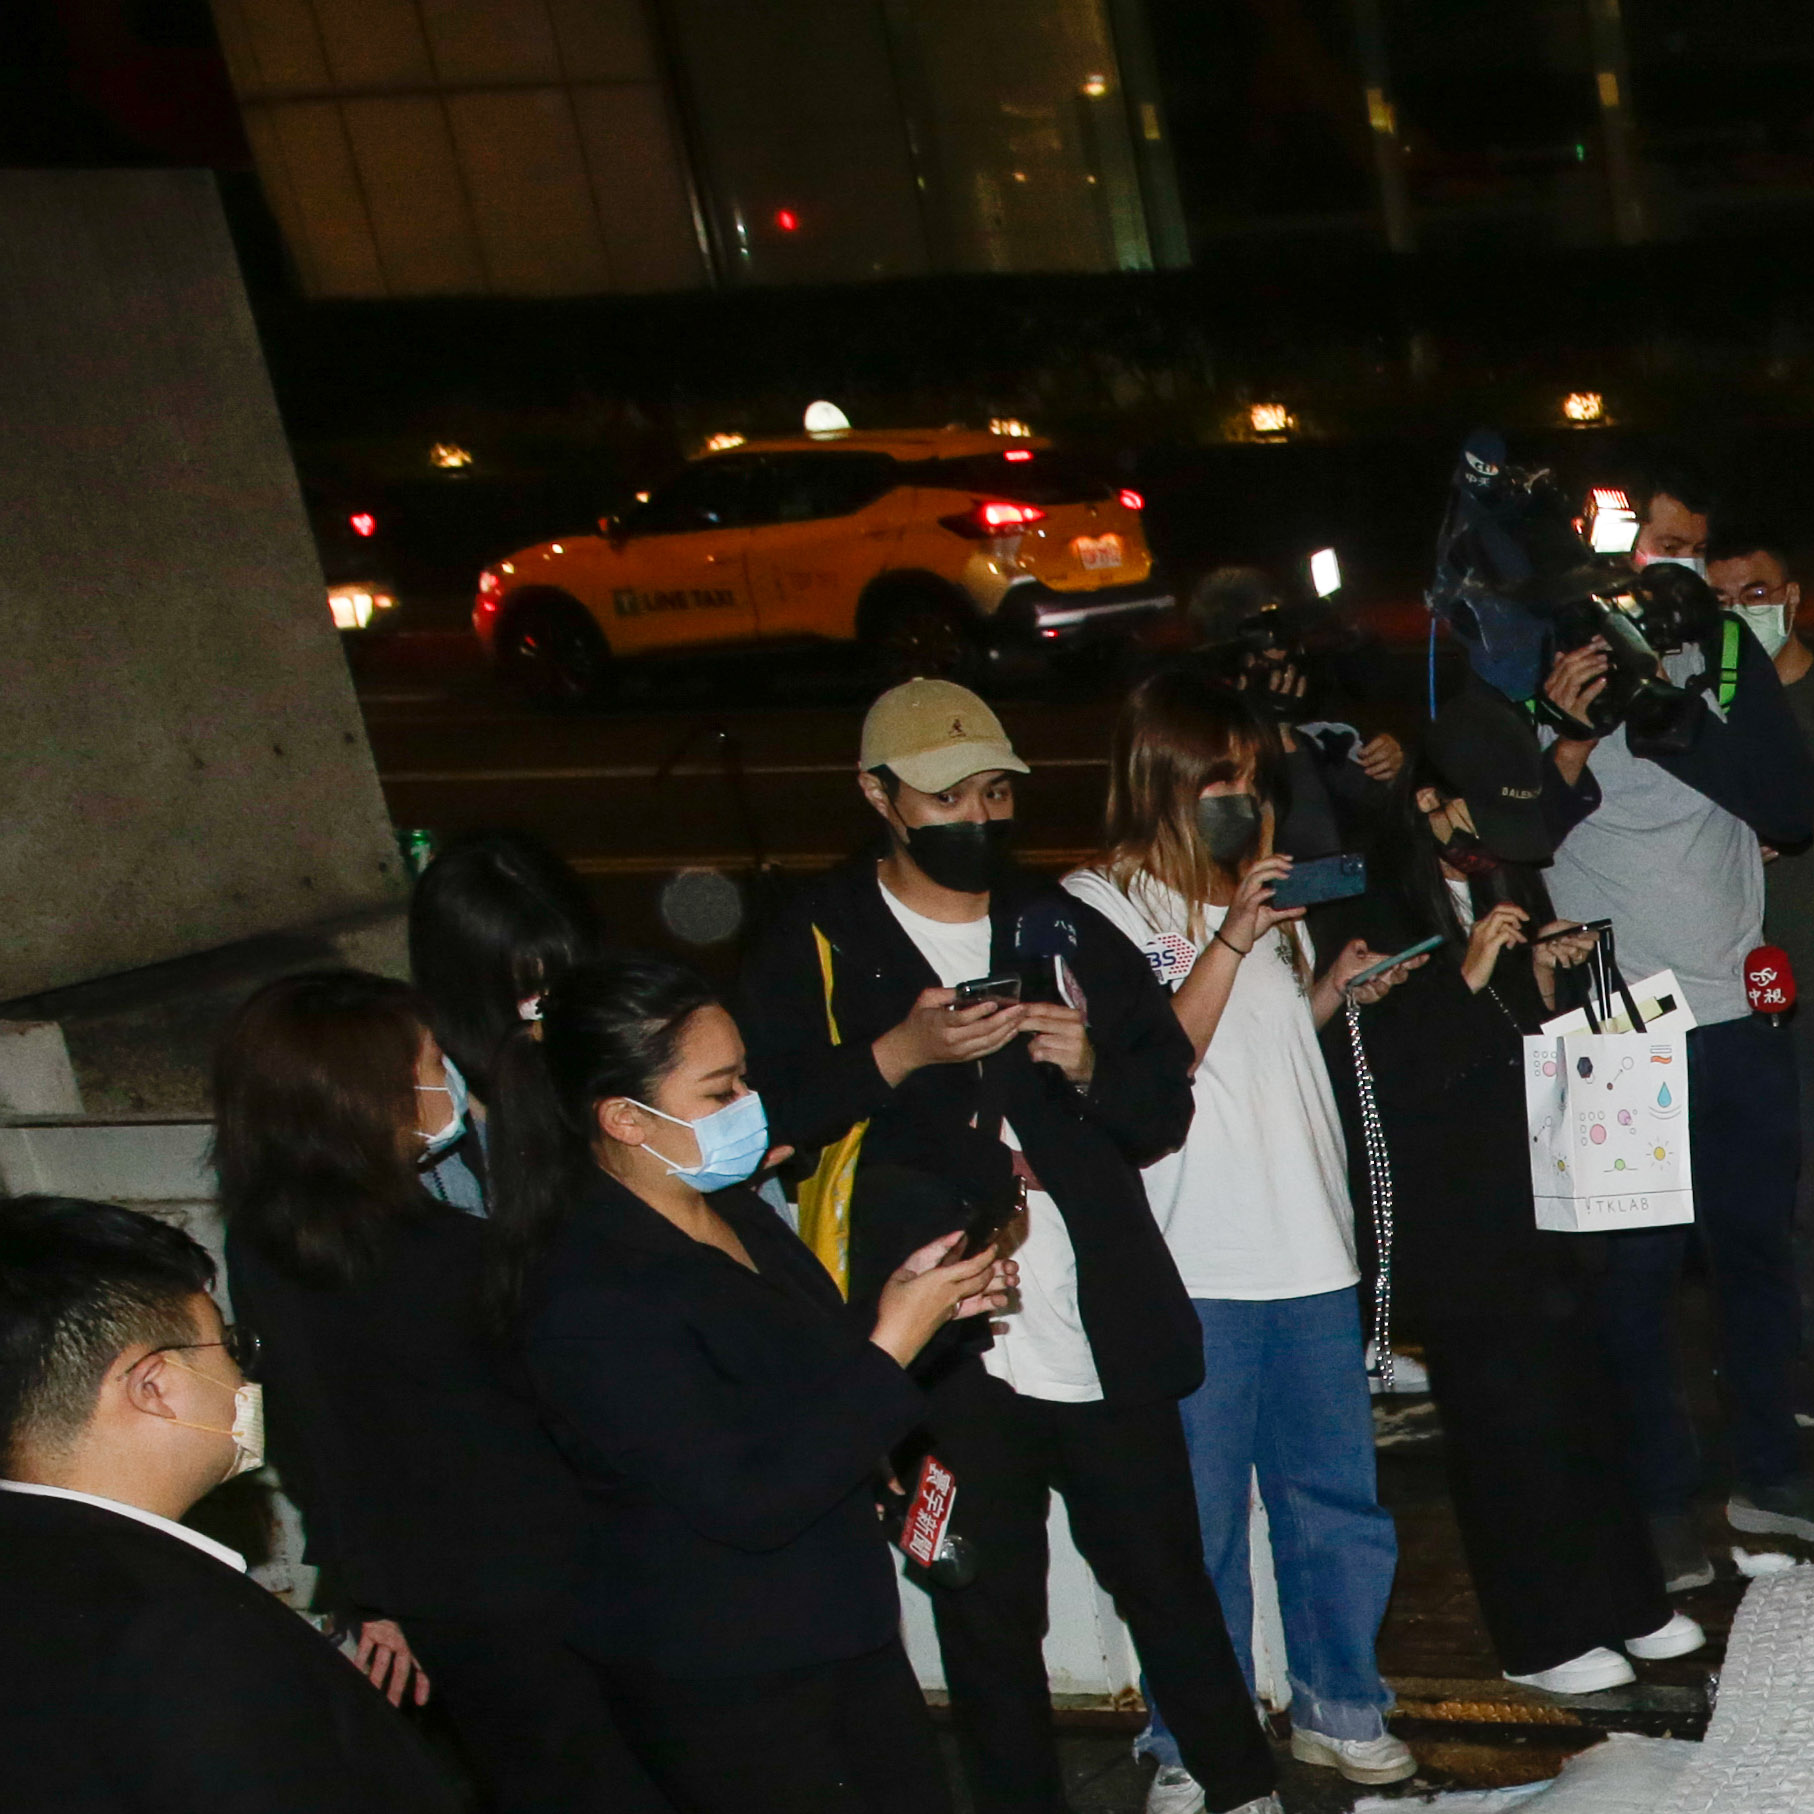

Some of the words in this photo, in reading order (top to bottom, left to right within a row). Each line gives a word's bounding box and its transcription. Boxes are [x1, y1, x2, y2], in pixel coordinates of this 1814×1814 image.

[1748, 987, 1787, 1007] 中視
[1596, 1198, 1649, 1214] TKLAB
[909, 1463, 951, 1563] 寰宇新聞
